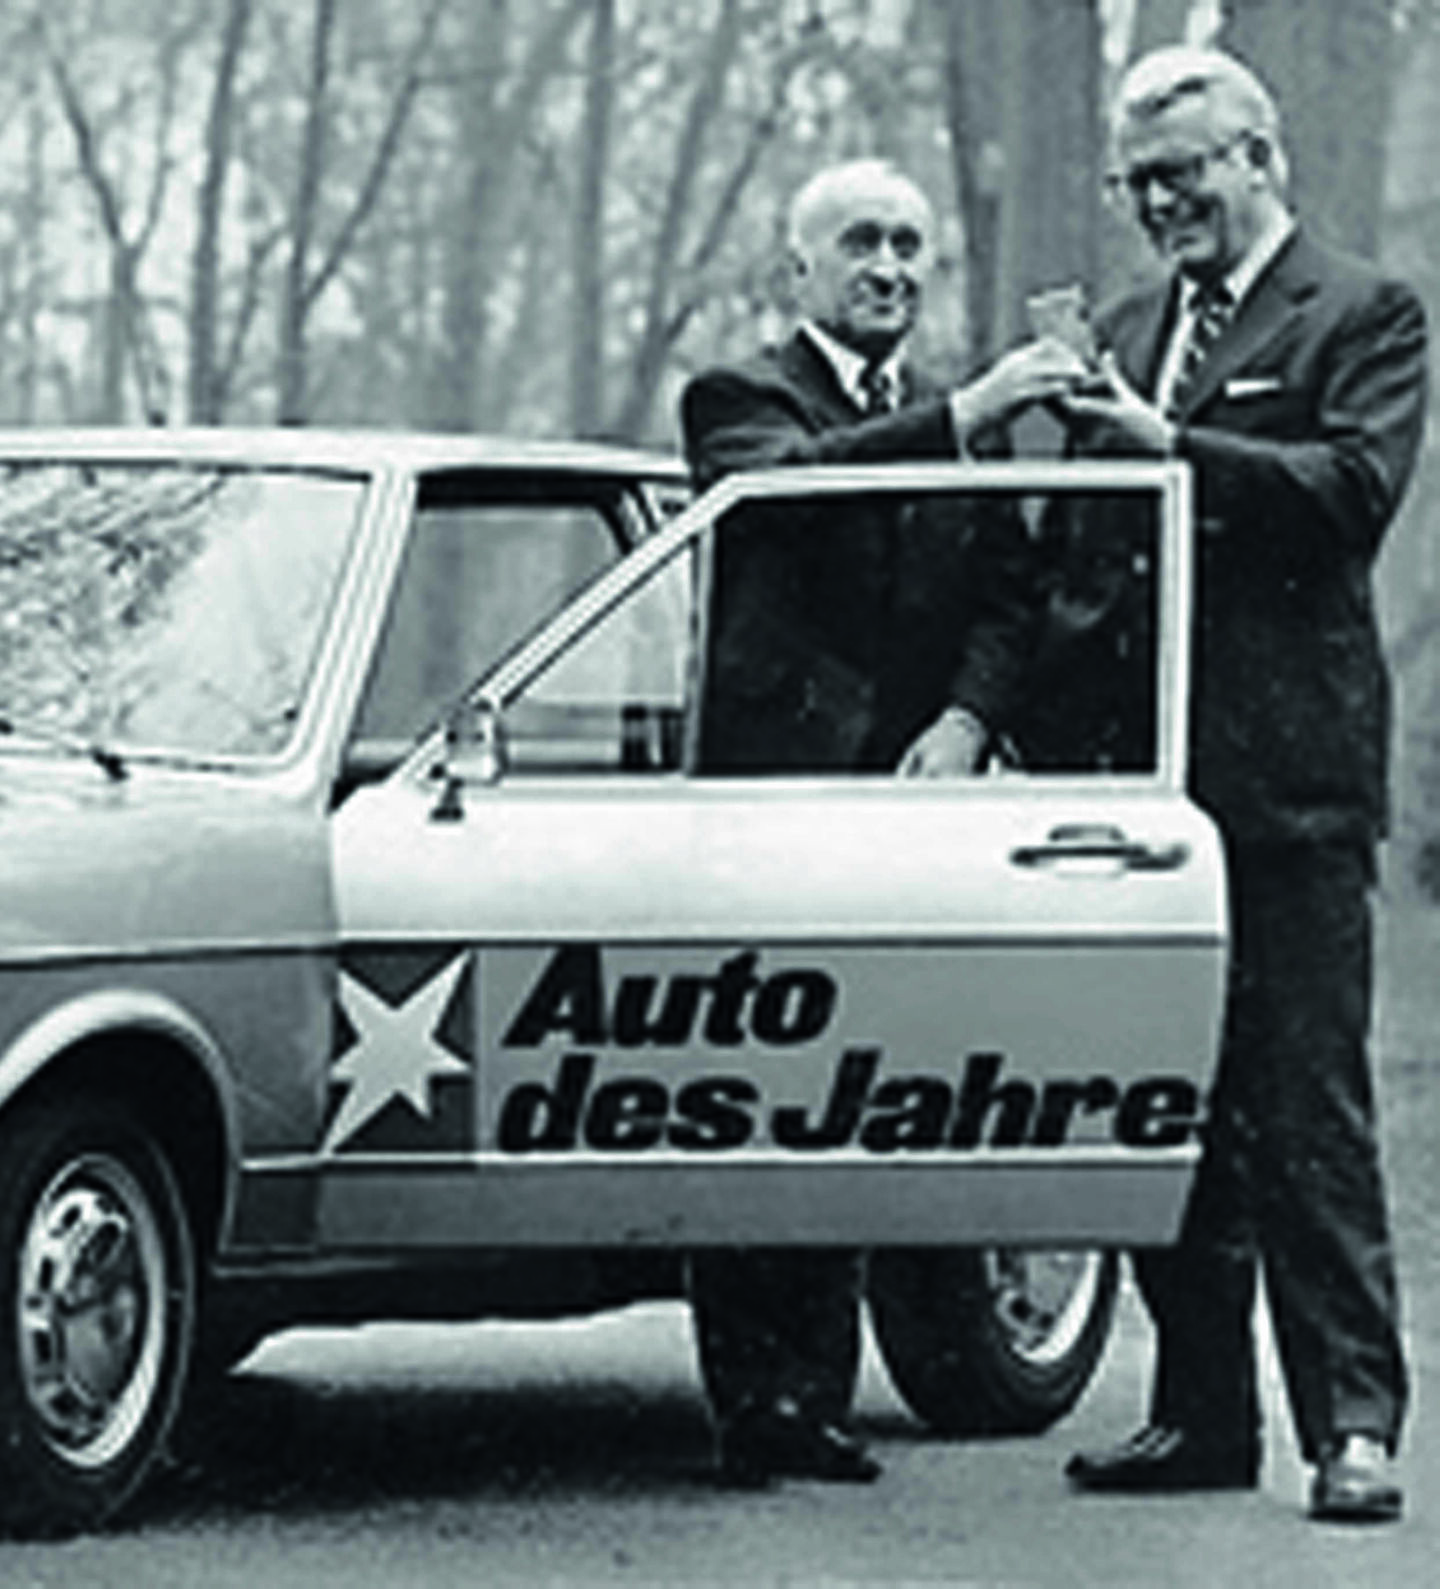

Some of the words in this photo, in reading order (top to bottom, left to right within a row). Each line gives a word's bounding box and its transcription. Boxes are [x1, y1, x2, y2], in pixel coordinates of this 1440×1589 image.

[501, 944, 837, 1047] Auto
[497, 1054, 761, 1152] des
[769, 1048, 1210, 1151] Jahre
